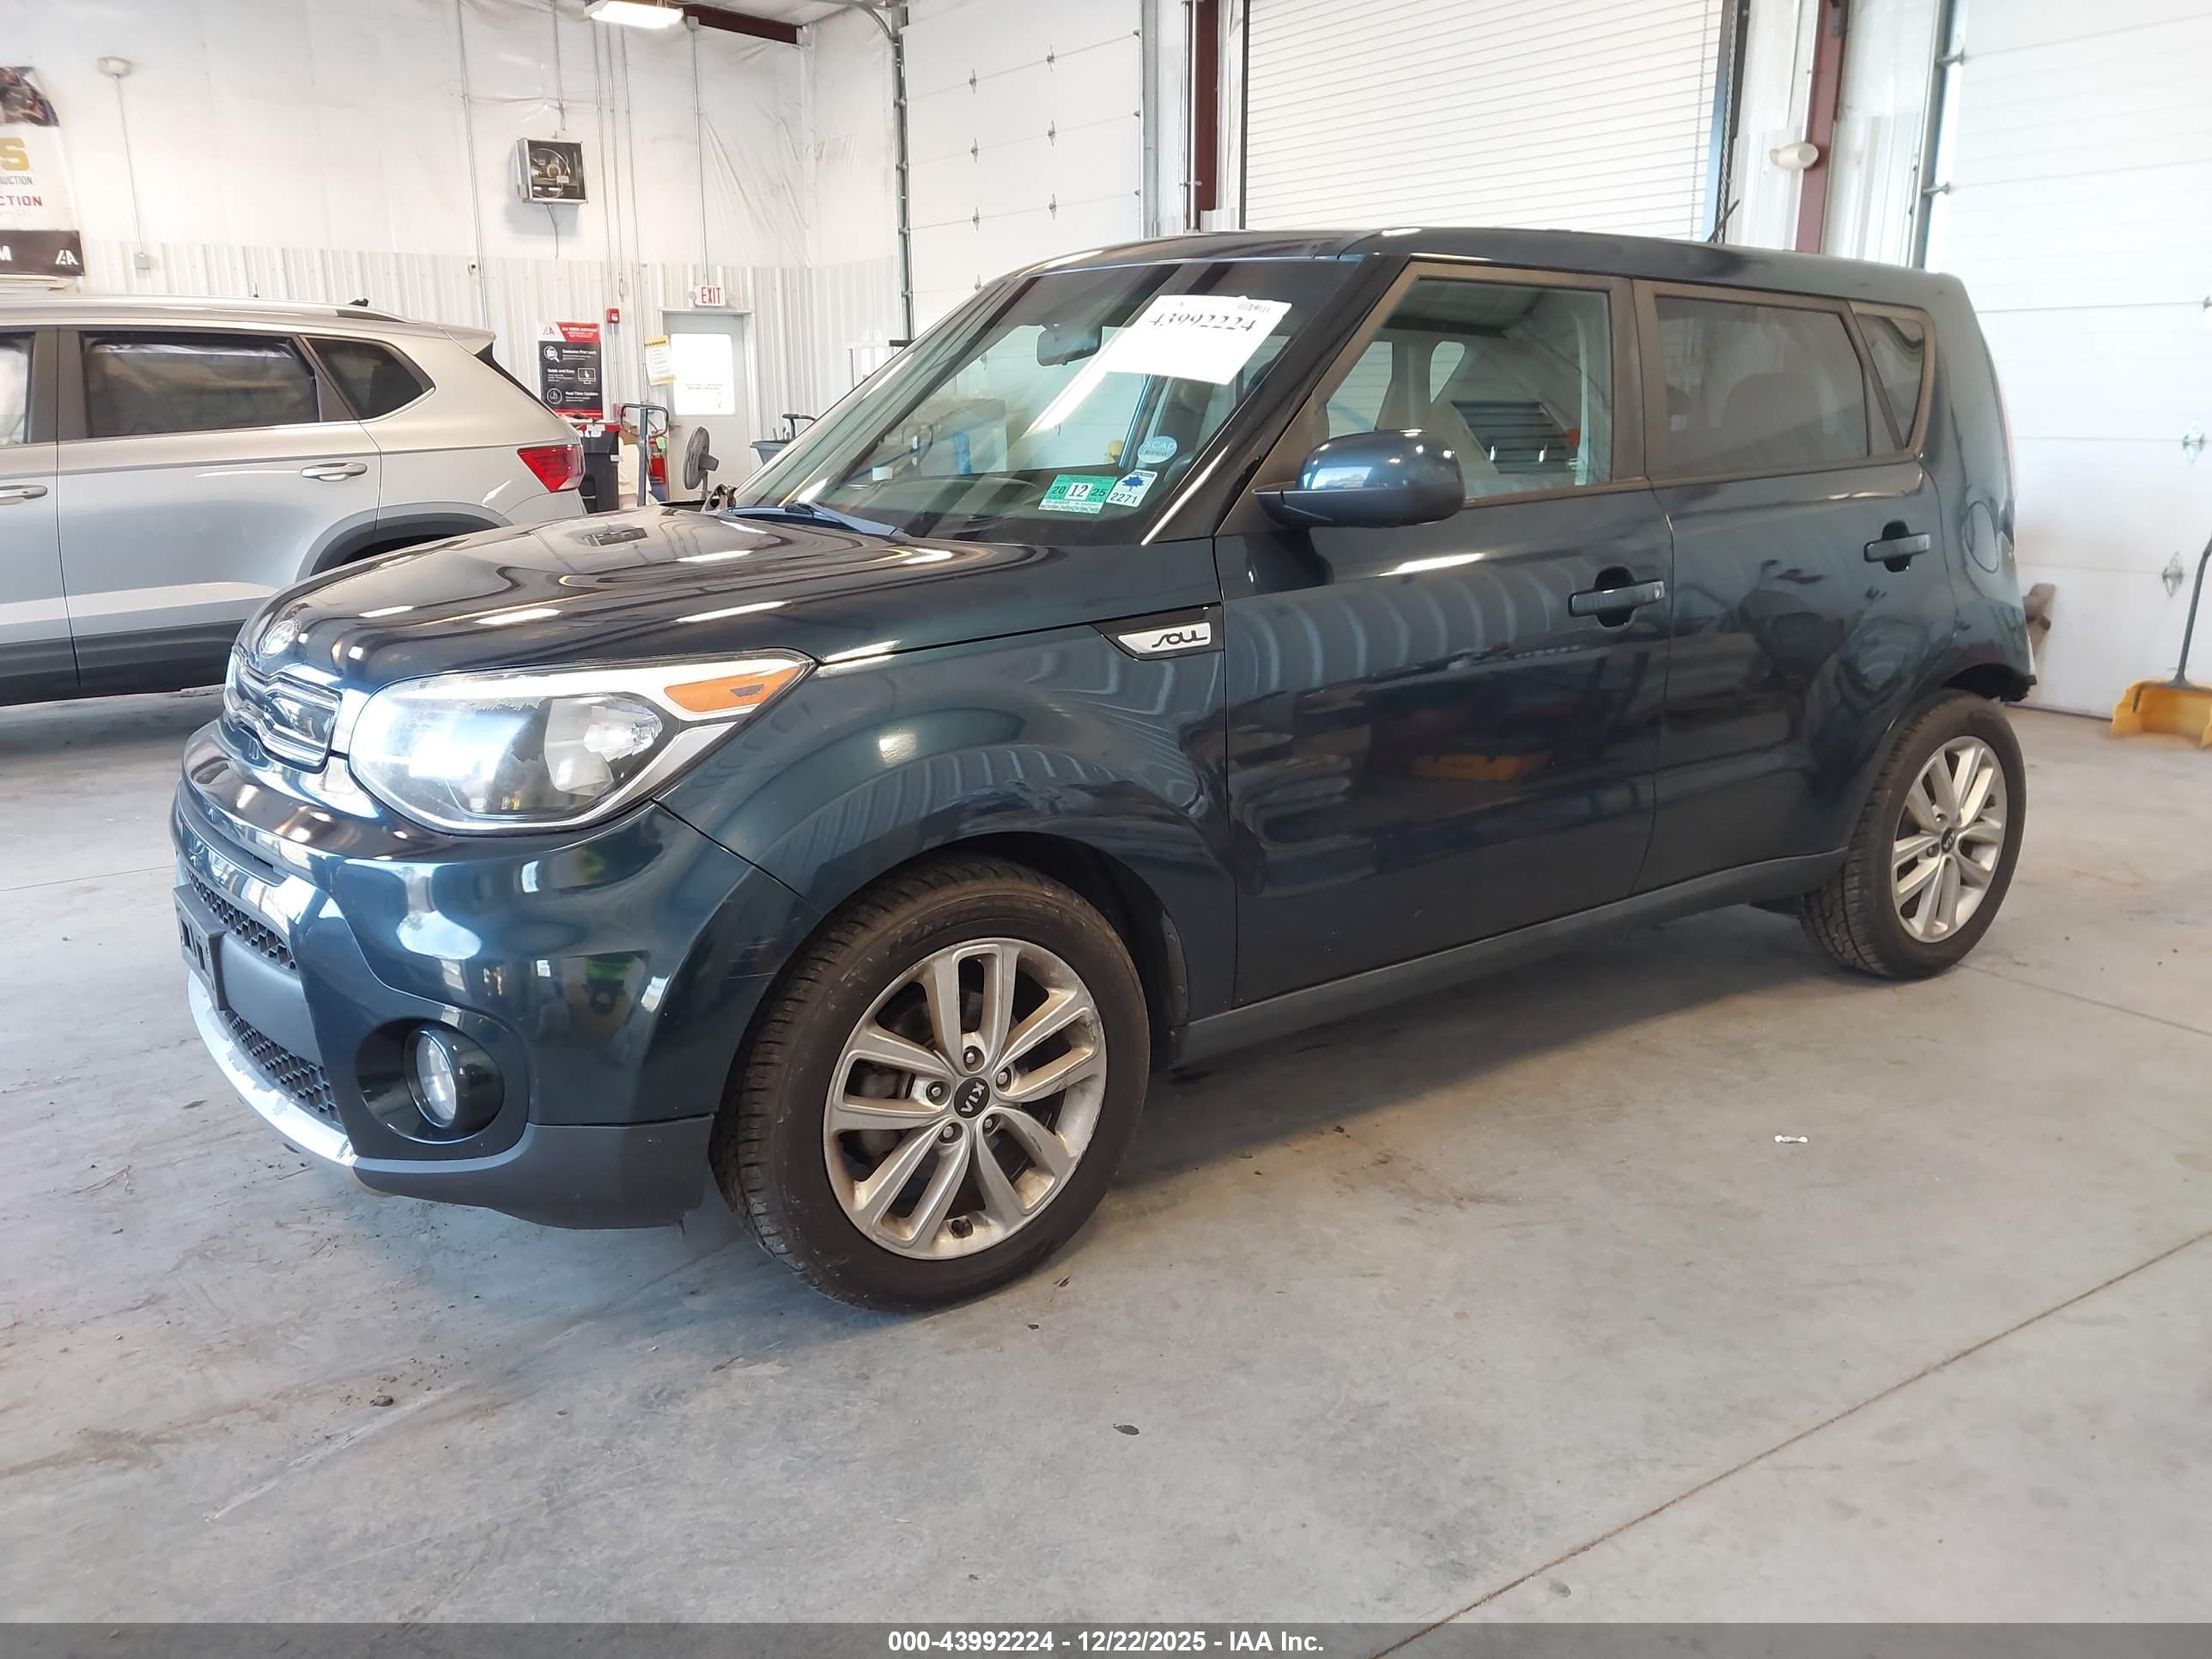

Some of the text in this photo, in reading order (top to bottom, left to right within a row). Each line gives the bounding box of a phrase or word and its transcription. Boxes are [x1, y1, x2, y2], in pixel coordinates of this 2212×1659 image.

[701, 287, 721, 304] EXIT
[1051, 484, 1106, 498] 20 12 25
[1110, 492, 1138, 504] 2271
[1152, 629, 1207, 648] SOUL
[960, 1082, 986, 1113] KIA
